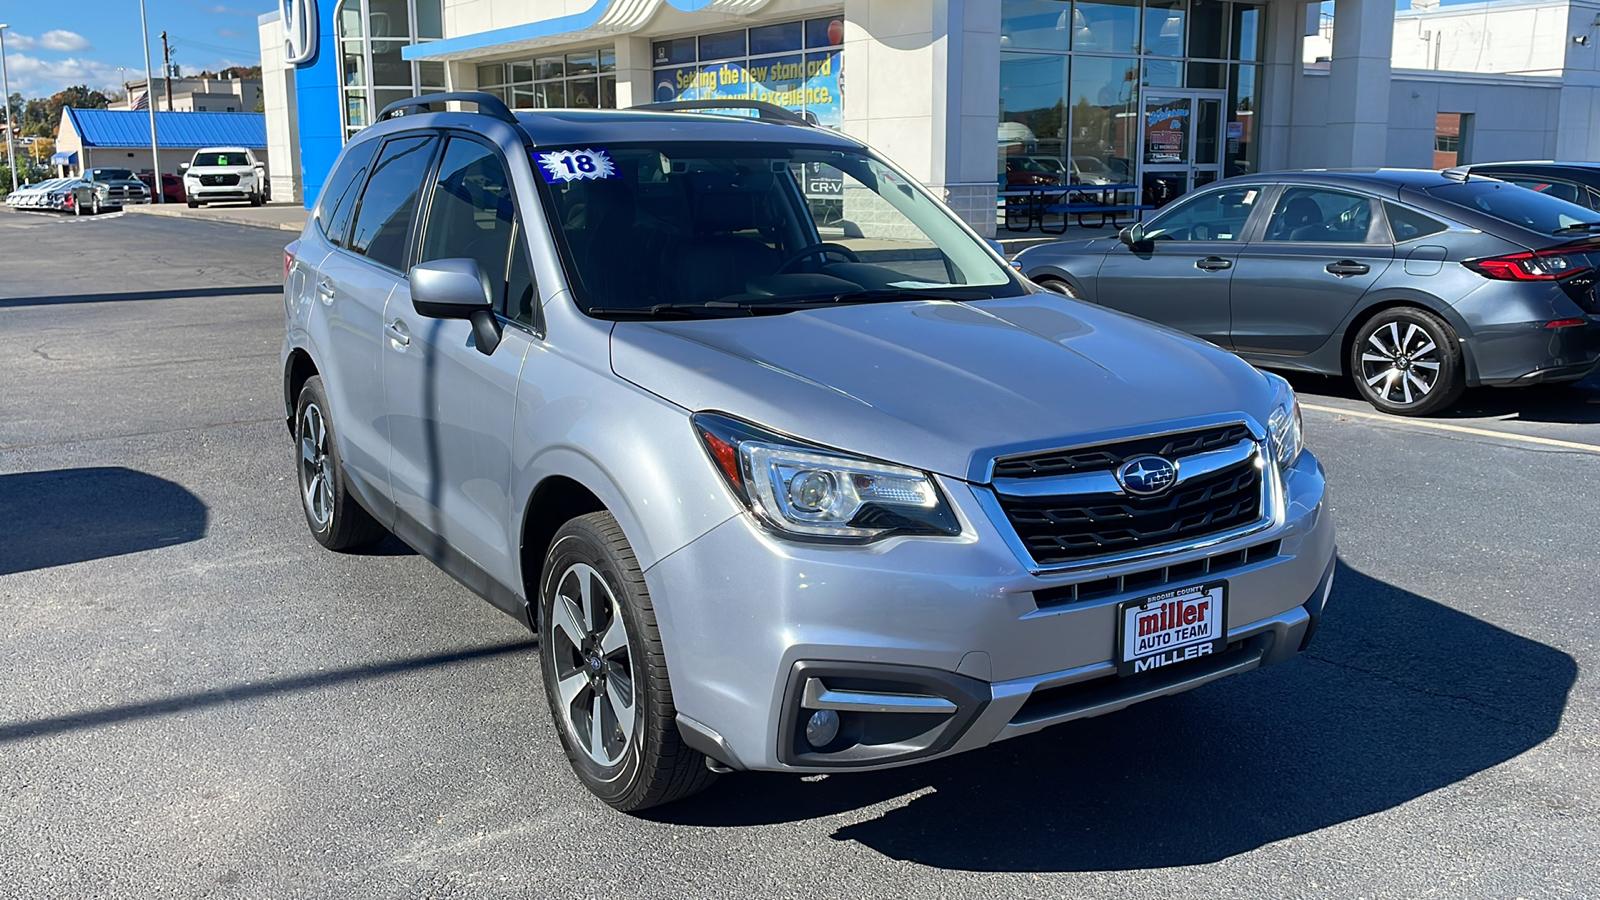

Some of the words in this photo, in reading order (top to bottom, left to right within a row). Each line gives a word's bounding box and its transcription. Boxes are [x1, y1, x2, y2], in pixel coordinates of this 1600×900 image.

[676, 69, 717, 91] Setting
[720, 64, 739, 85] the
[741, 65, 768, 84] new
[761, 84, 832, 107] excellence.
[560, 155, 597, 174] 18
[810, 182, 842, 192] CR-V
[1147, 591, 1175, 603] BROOME
[1176, 585, 1204, 596] COUNTY
[1138, 600, 1209, 638] miller
[1138, 632, 1171, 652] AUTO
[1175, 623, 1208, 642] TEAM
[1134, 642, 1214, 674] MILLER
